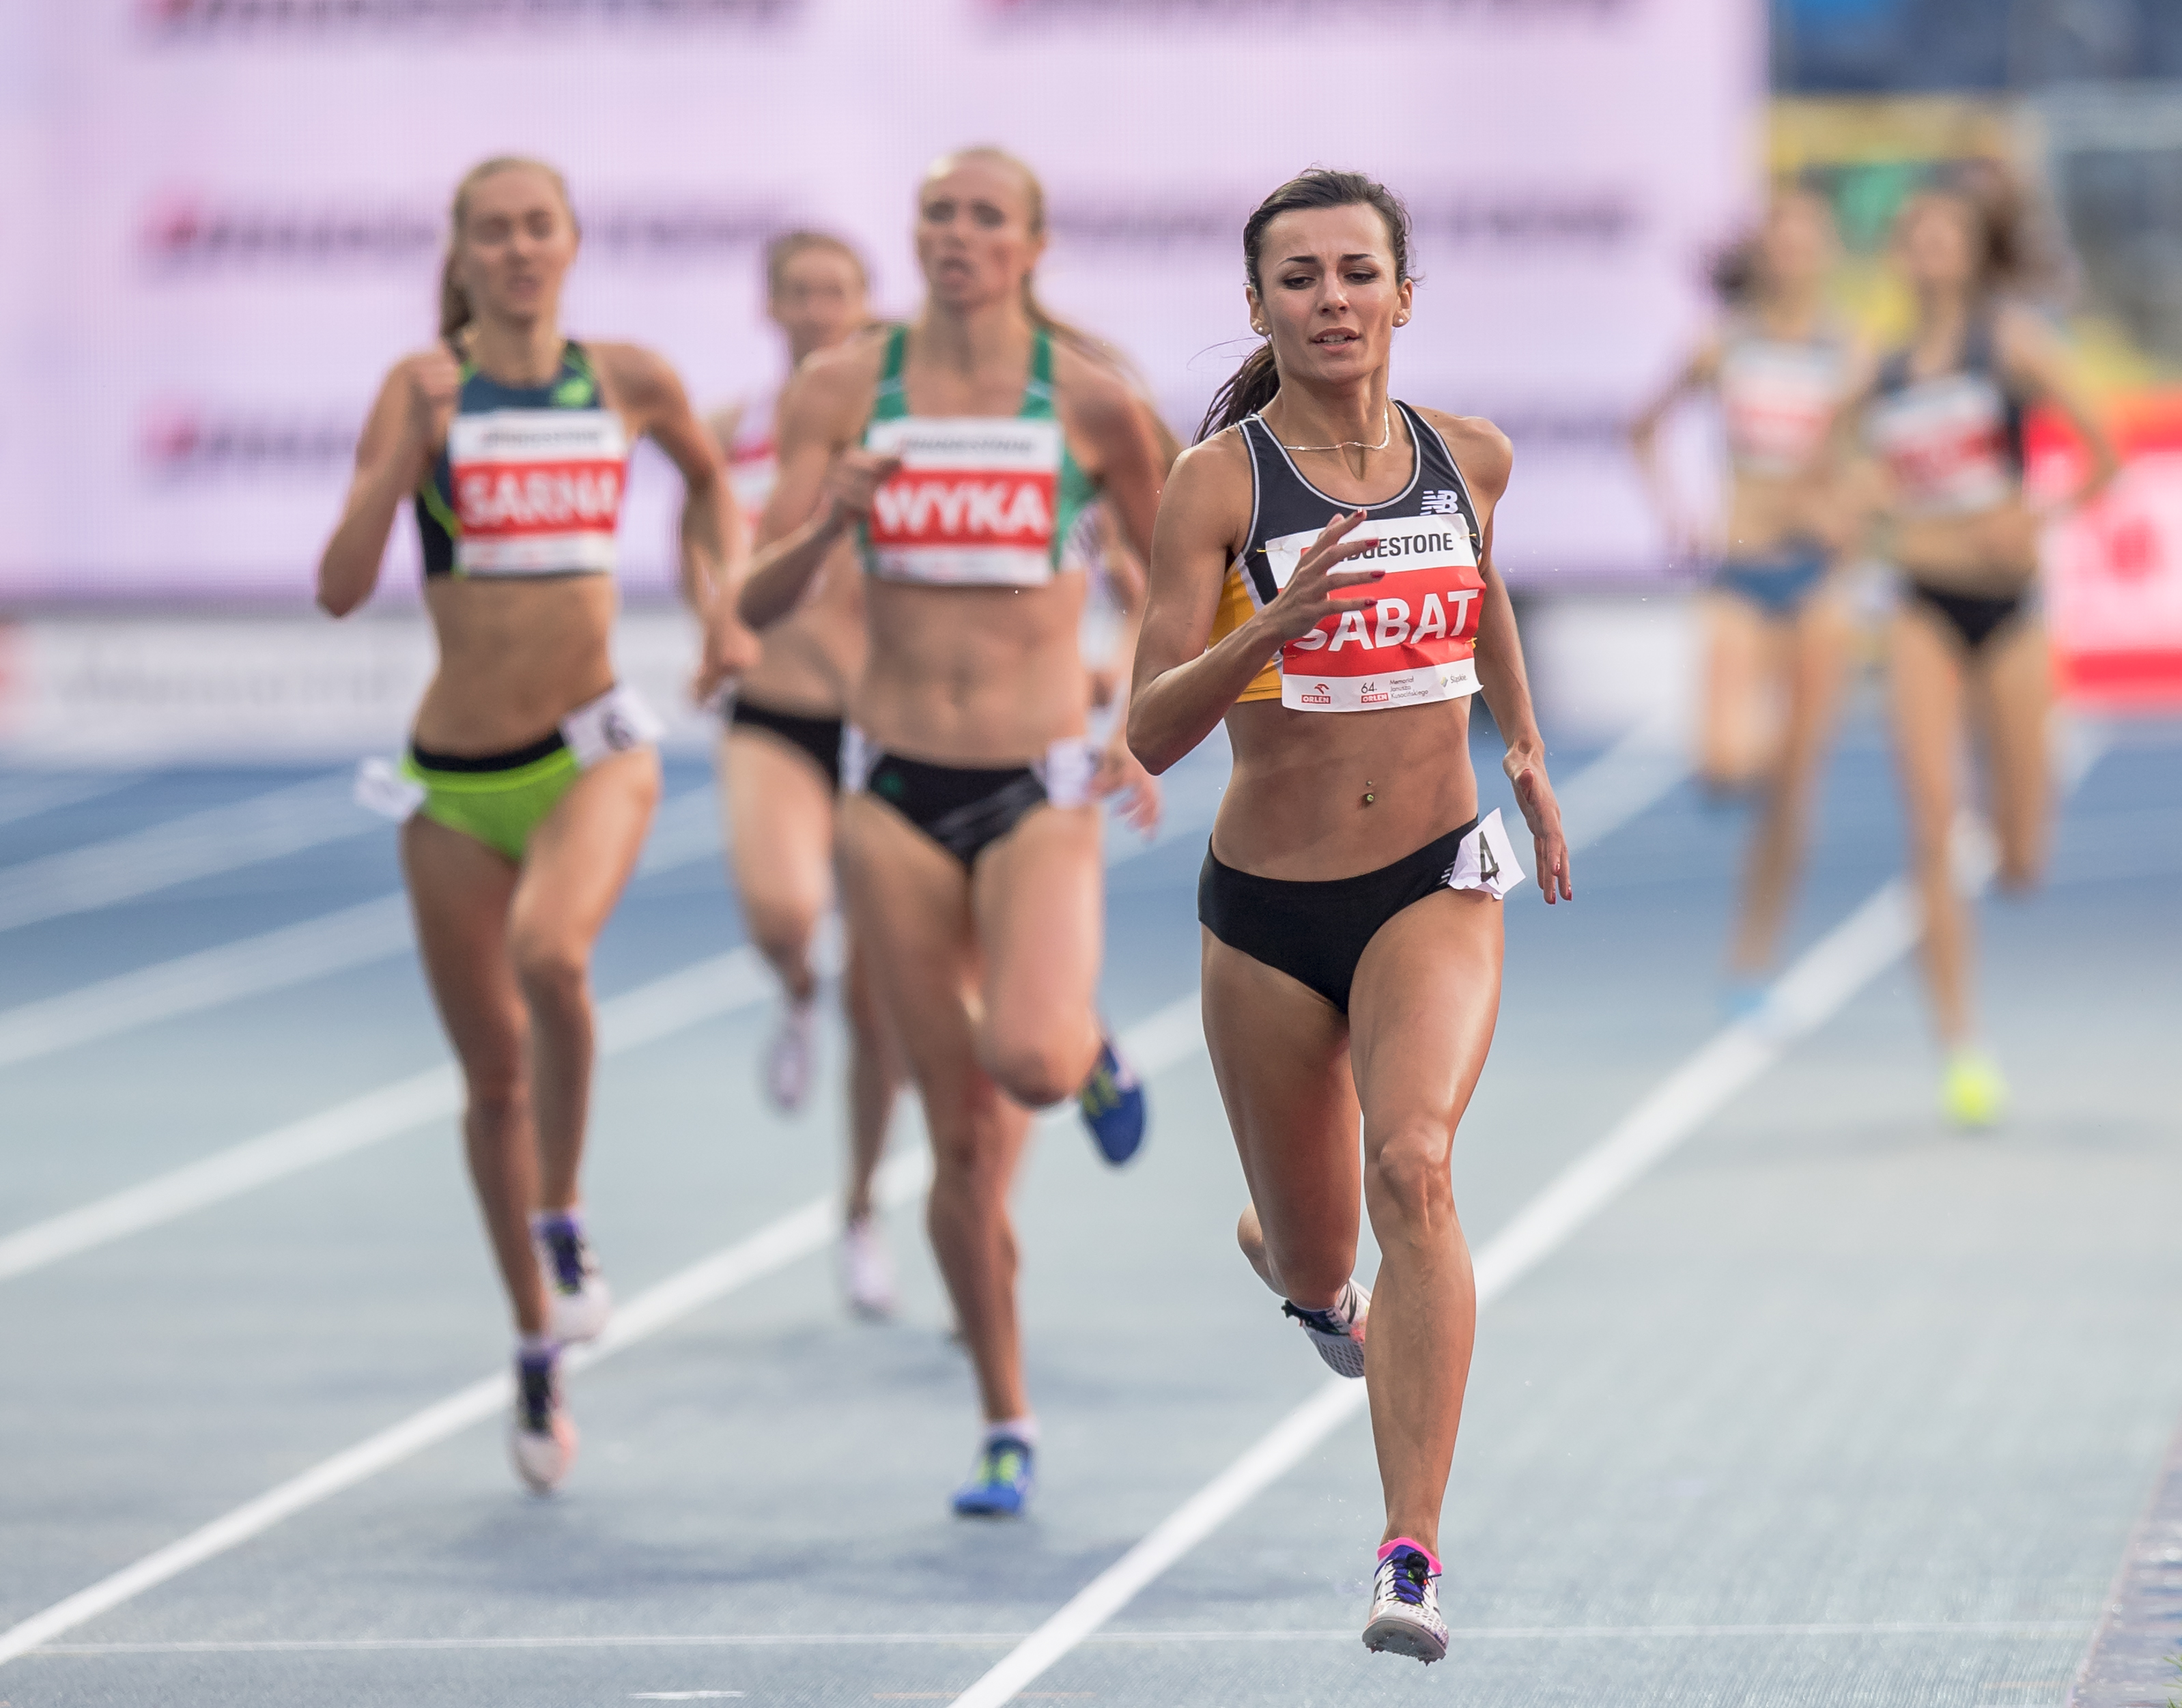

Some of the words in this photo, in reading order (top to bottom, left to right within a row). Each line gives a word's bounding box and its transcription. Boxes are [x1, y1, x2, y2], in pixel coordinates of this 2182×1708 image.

[875, 483, 1049, 535] WYKA
[1362, 693, 1388, 702] ORLEN
[1478, 830, 1500, 885] 4
